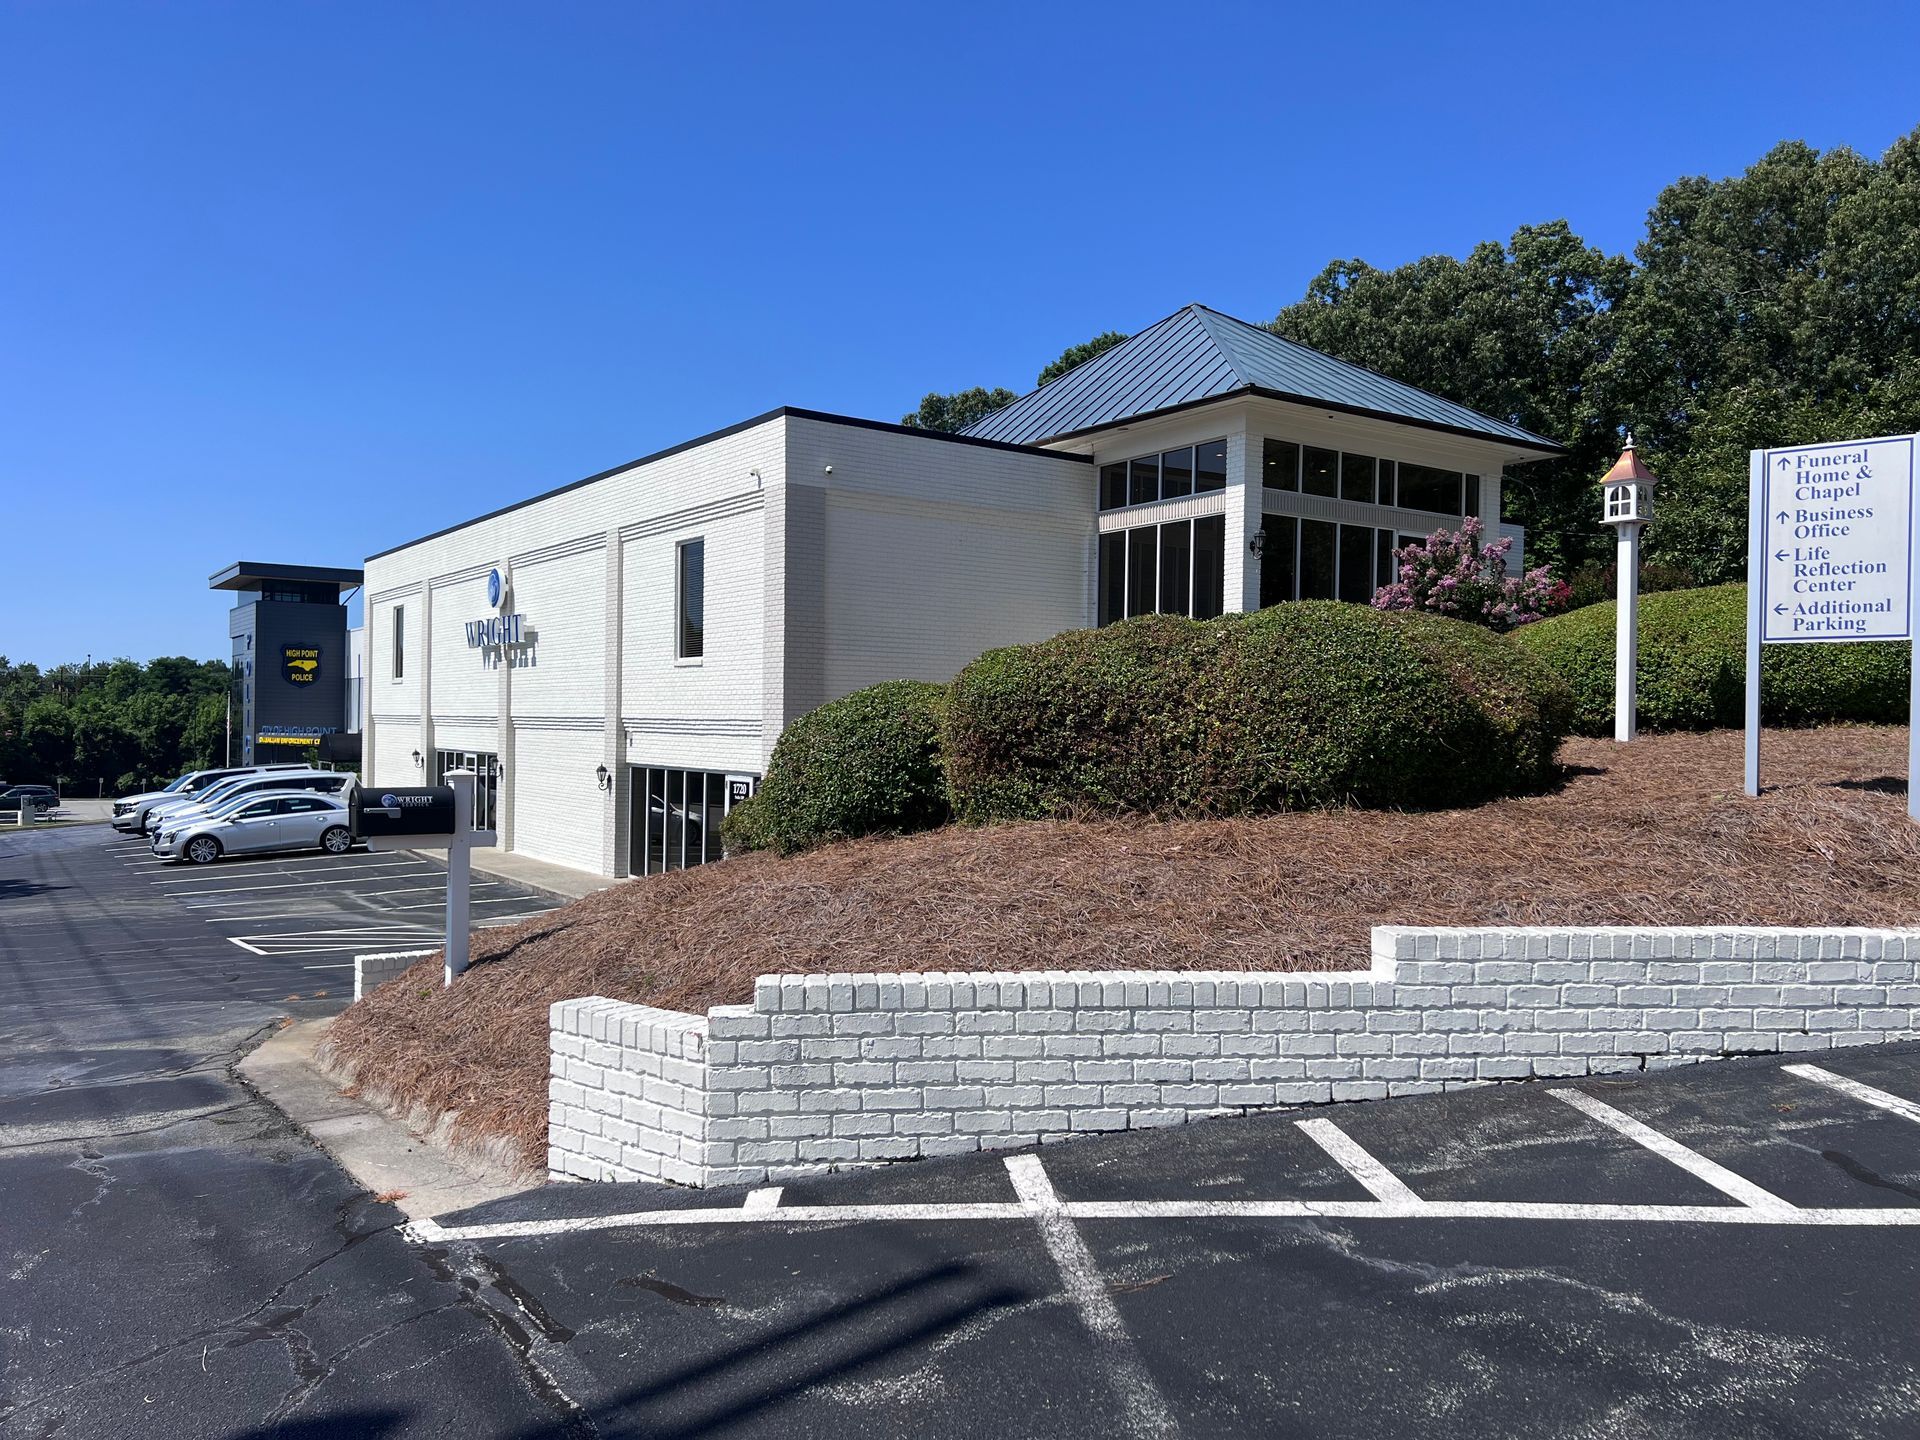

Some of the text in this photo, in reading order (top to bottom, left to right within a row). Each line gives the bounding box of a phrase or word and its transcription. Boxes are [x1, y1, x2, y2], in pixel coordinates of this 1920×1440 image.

[1796, 449, 1869, 469] Funeral
[1796, 465, 1873, 485] Home &
[1795, 482, 1861, 501] Chapel
[1795, 507, 1874, 523] Business
[1794, 524, 1850, 539] Office
[1794, 546, 1830, 561] Life
[1793, 560, 1887, 577] Reflection
[1793, 578, 1856, 594] Center
[1793, 598, 1892, 616] Additional
[465, 614, 521, 648] WRIGHT
[1793, 617, 1867, 633] Parking
[286, 649, 319, 658] HIGH POINT
[291, 673, 313, 681] POLICE
[284, 726, 304, 735] HIGH
[305, 726, 337, 736] POINT
[733, 783, 747, 795] 1720
[397, 795, 433, 804] WRIGHT
